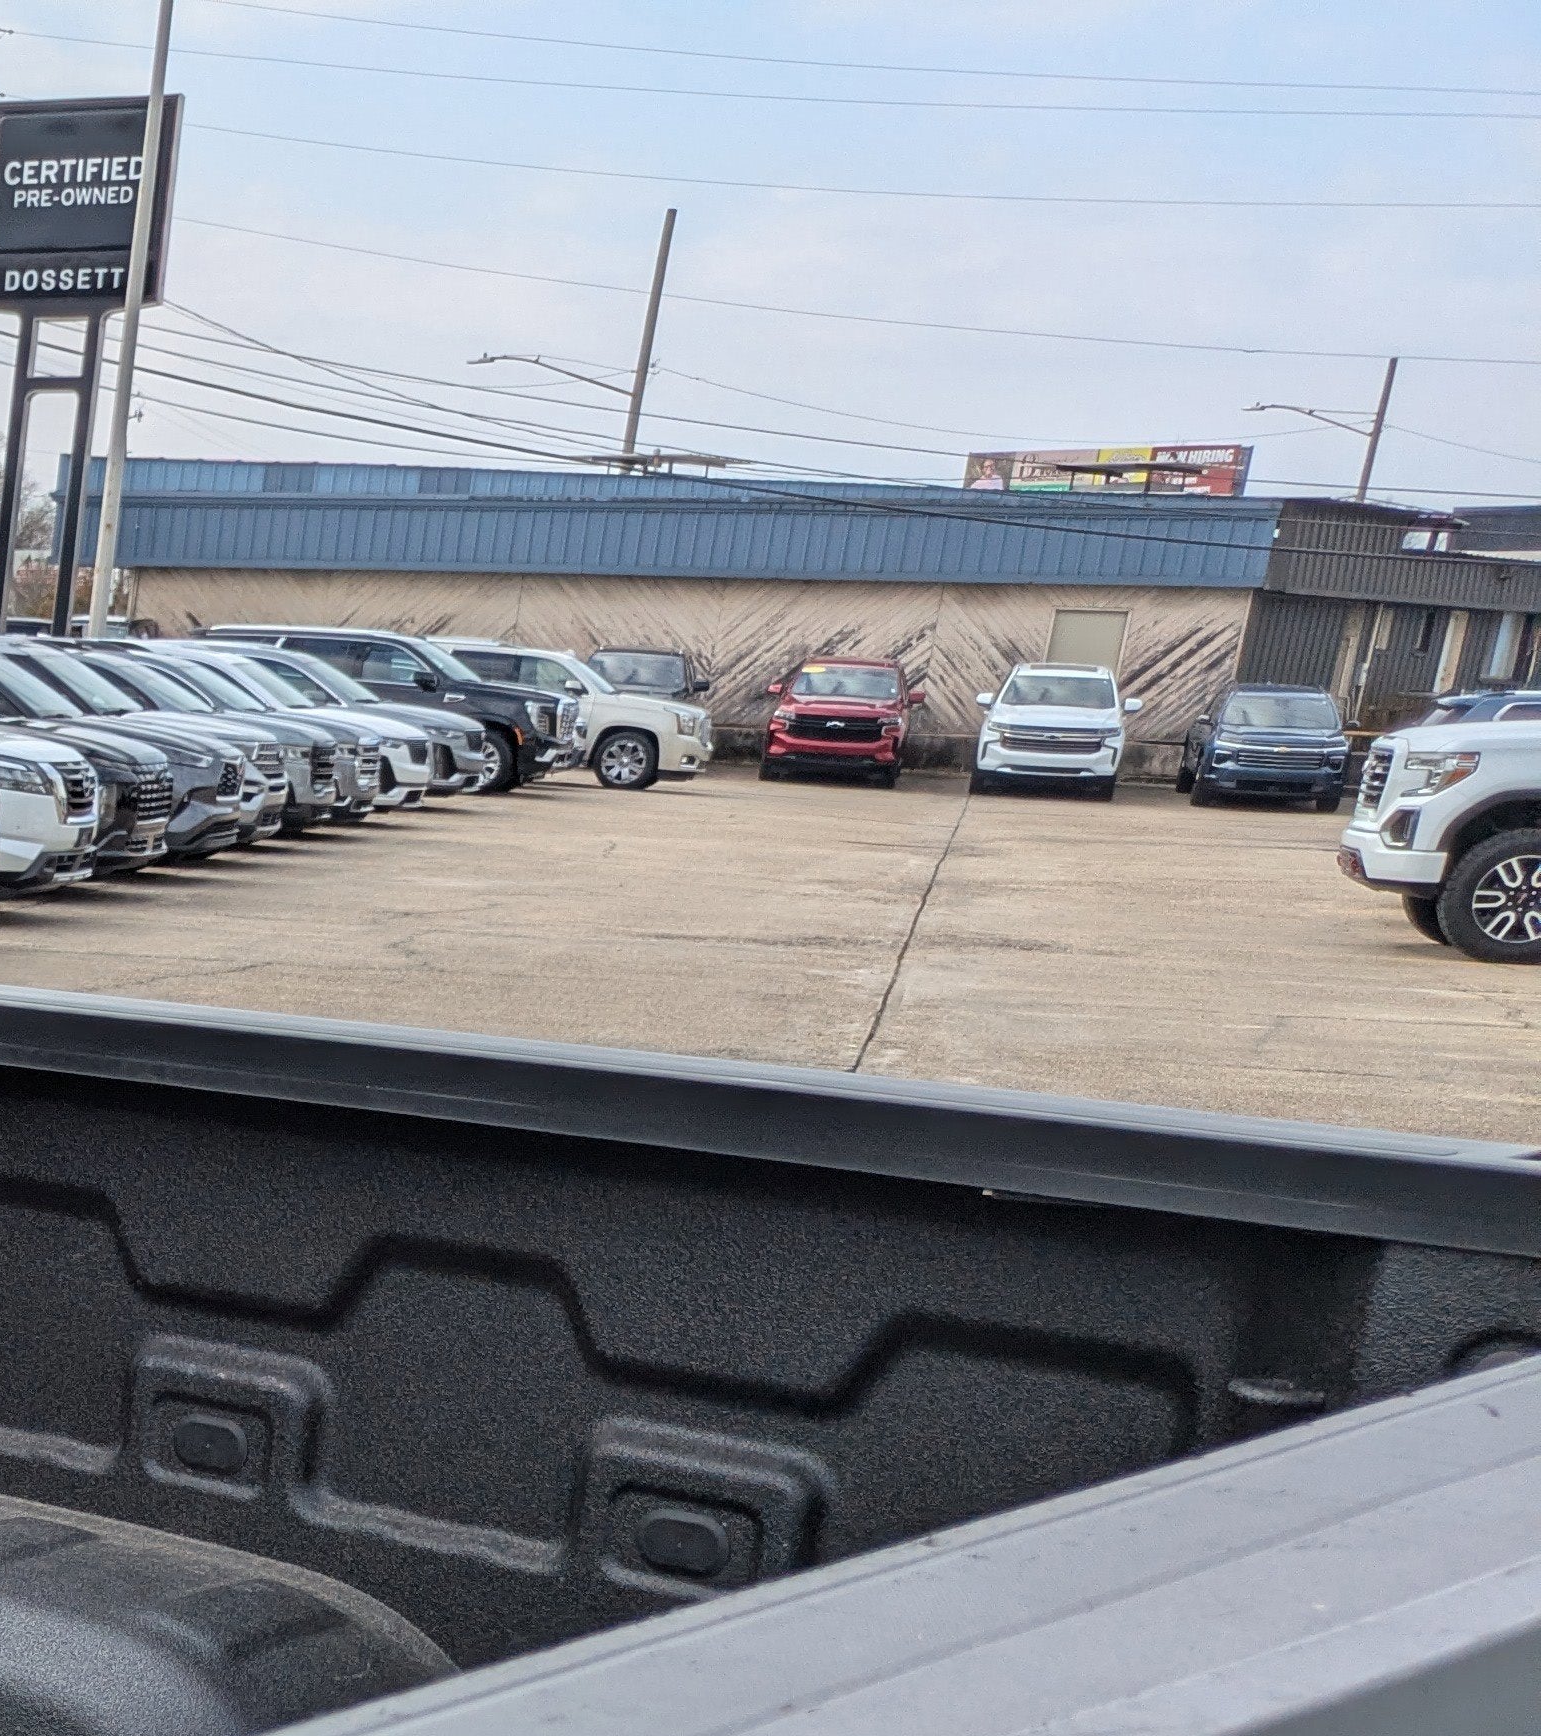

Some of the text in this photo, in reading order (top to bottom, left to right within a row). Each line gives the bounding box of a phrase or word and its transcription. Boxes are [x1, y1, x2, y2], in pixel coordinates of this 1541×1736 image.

[3, 157, 144, 186] CERTIFIED
[13, 186, 133, 208] PRE-OWNED
[4, 267, 126, 292] DOSSETT
